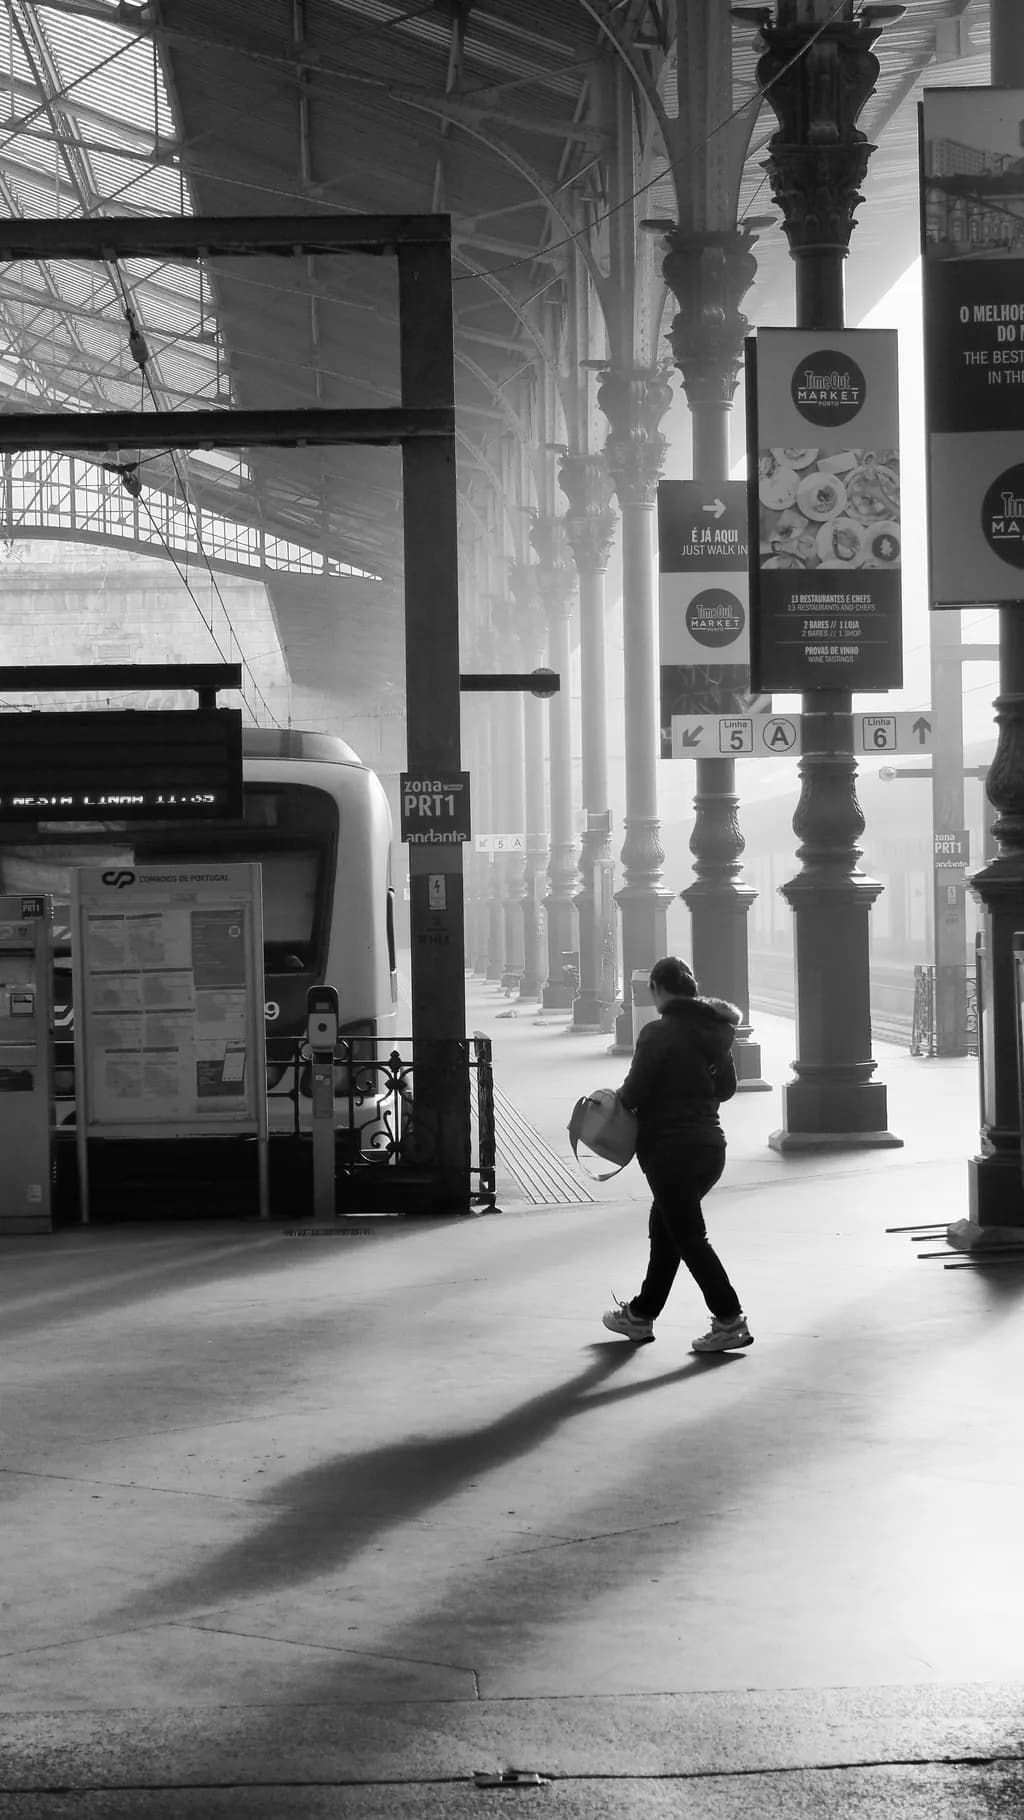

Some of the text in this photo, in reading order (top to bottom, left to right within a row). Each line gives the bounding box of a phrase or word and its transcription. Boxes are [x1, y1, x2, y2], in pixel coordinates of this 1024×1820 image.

[960, 306, 969, 323] O
[997, 325, 1016, 342] DO
[963, 350, 1024, 365] THE BEST
[804, 370, 851, 389] Time Out
[988, 370, 1001, 384] IN
[798, 391, 859, 400] MARKET
[691, 527, 738, 544] É JÁ AQUI
[681, 544, 748, 556] JUST WALK IN
[791, 594, 871, 603] 13 RESTAURANTES E CHEFS
[803, 620, 808, 629] 2
[809, 620, 829, 629] BARES
[844, 620, 859, 629] LOJA
[805, 646, 859, 655] PROVAS DE VINHO
[723, 720, 748, 729] Linha
[867, 717, 890, 727] Linha
[729, 730, 744, 750] 5
[769, 726, 789, 745] A
[873, 728, 887, 748] 6
[404, 780, 442, 793] zona
[404, 794, 455, 816] PRT1
[406, 828, 467, 843] andante
[498, 838, 522, 848] 5 A
[935, 841, 961, 854] PRT1
[935, 860, 968, 868] andante
[190, 874, 228, 882] PORTUGAL
